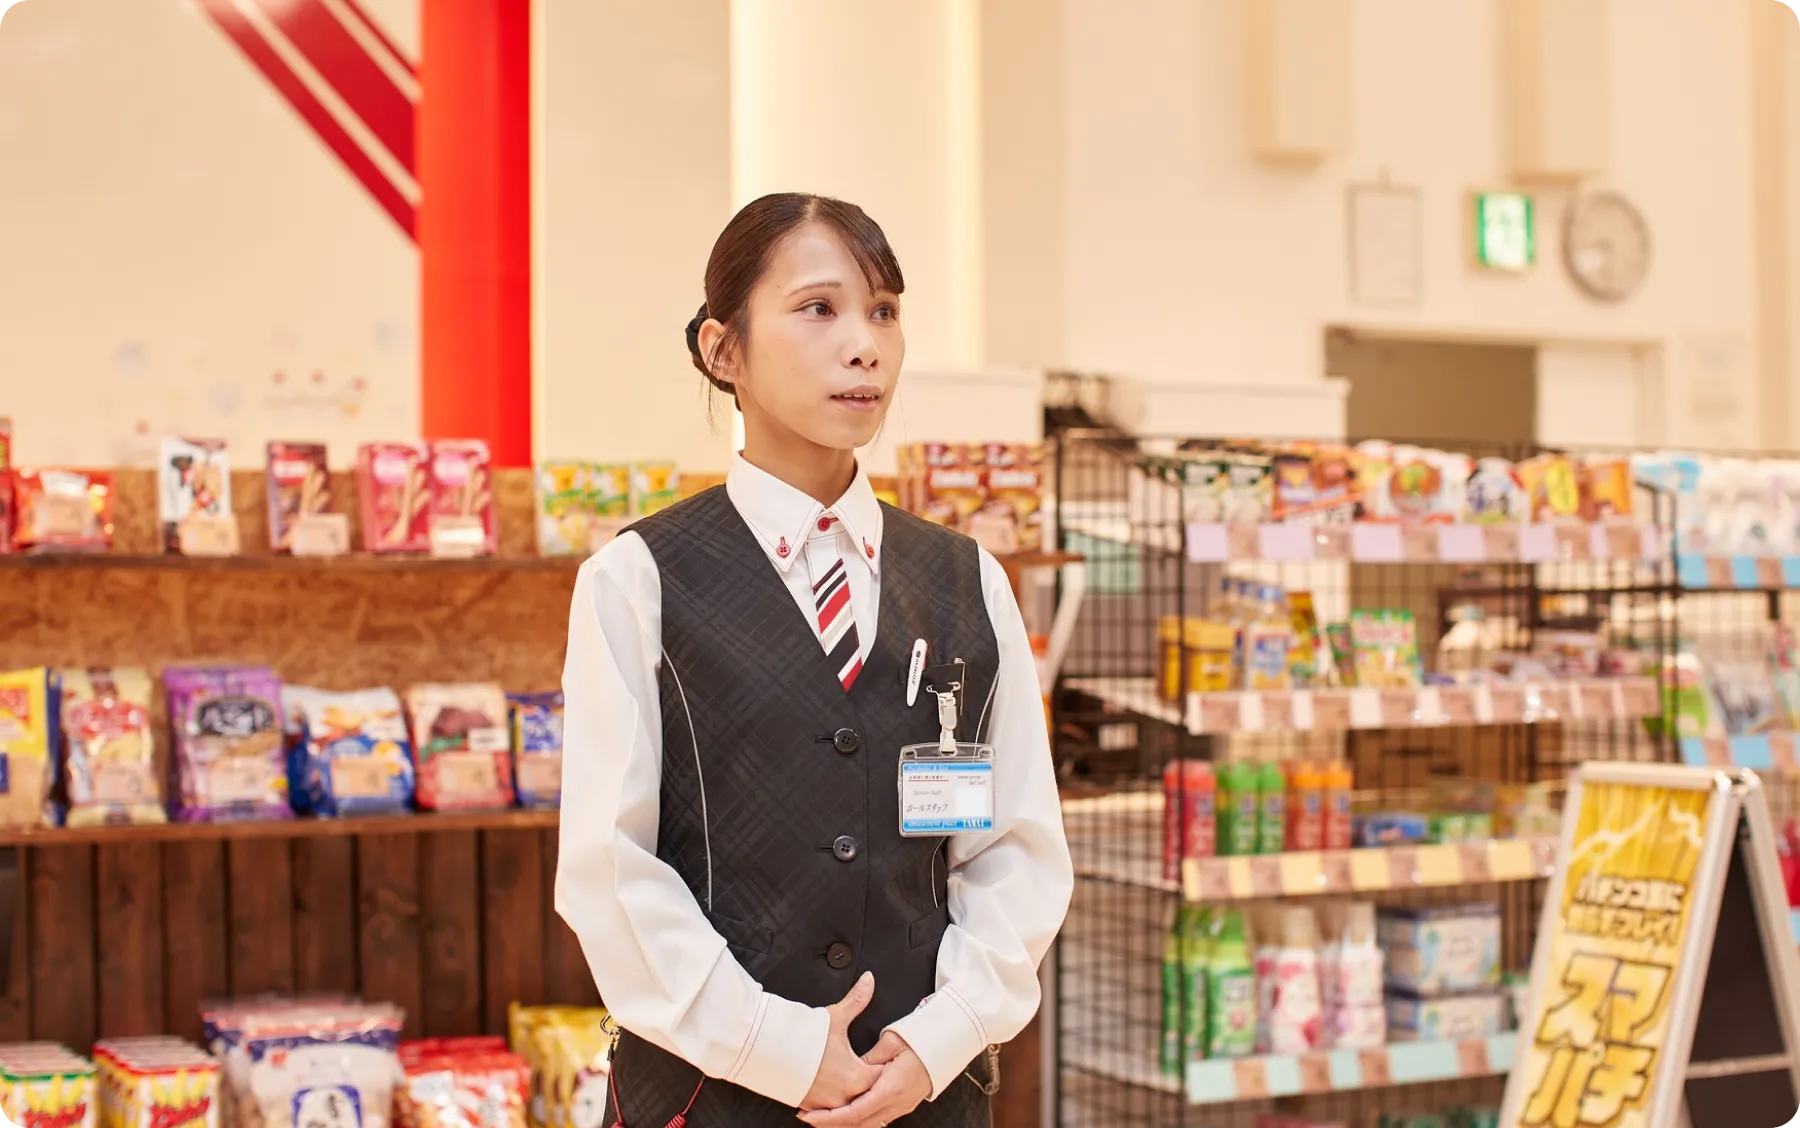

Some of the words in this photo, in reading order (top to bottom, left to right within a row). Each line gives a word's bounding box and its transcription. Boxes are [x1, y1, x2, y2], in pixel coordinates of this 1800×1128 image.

[906, 803, 948, 814] ホールスタッフ
